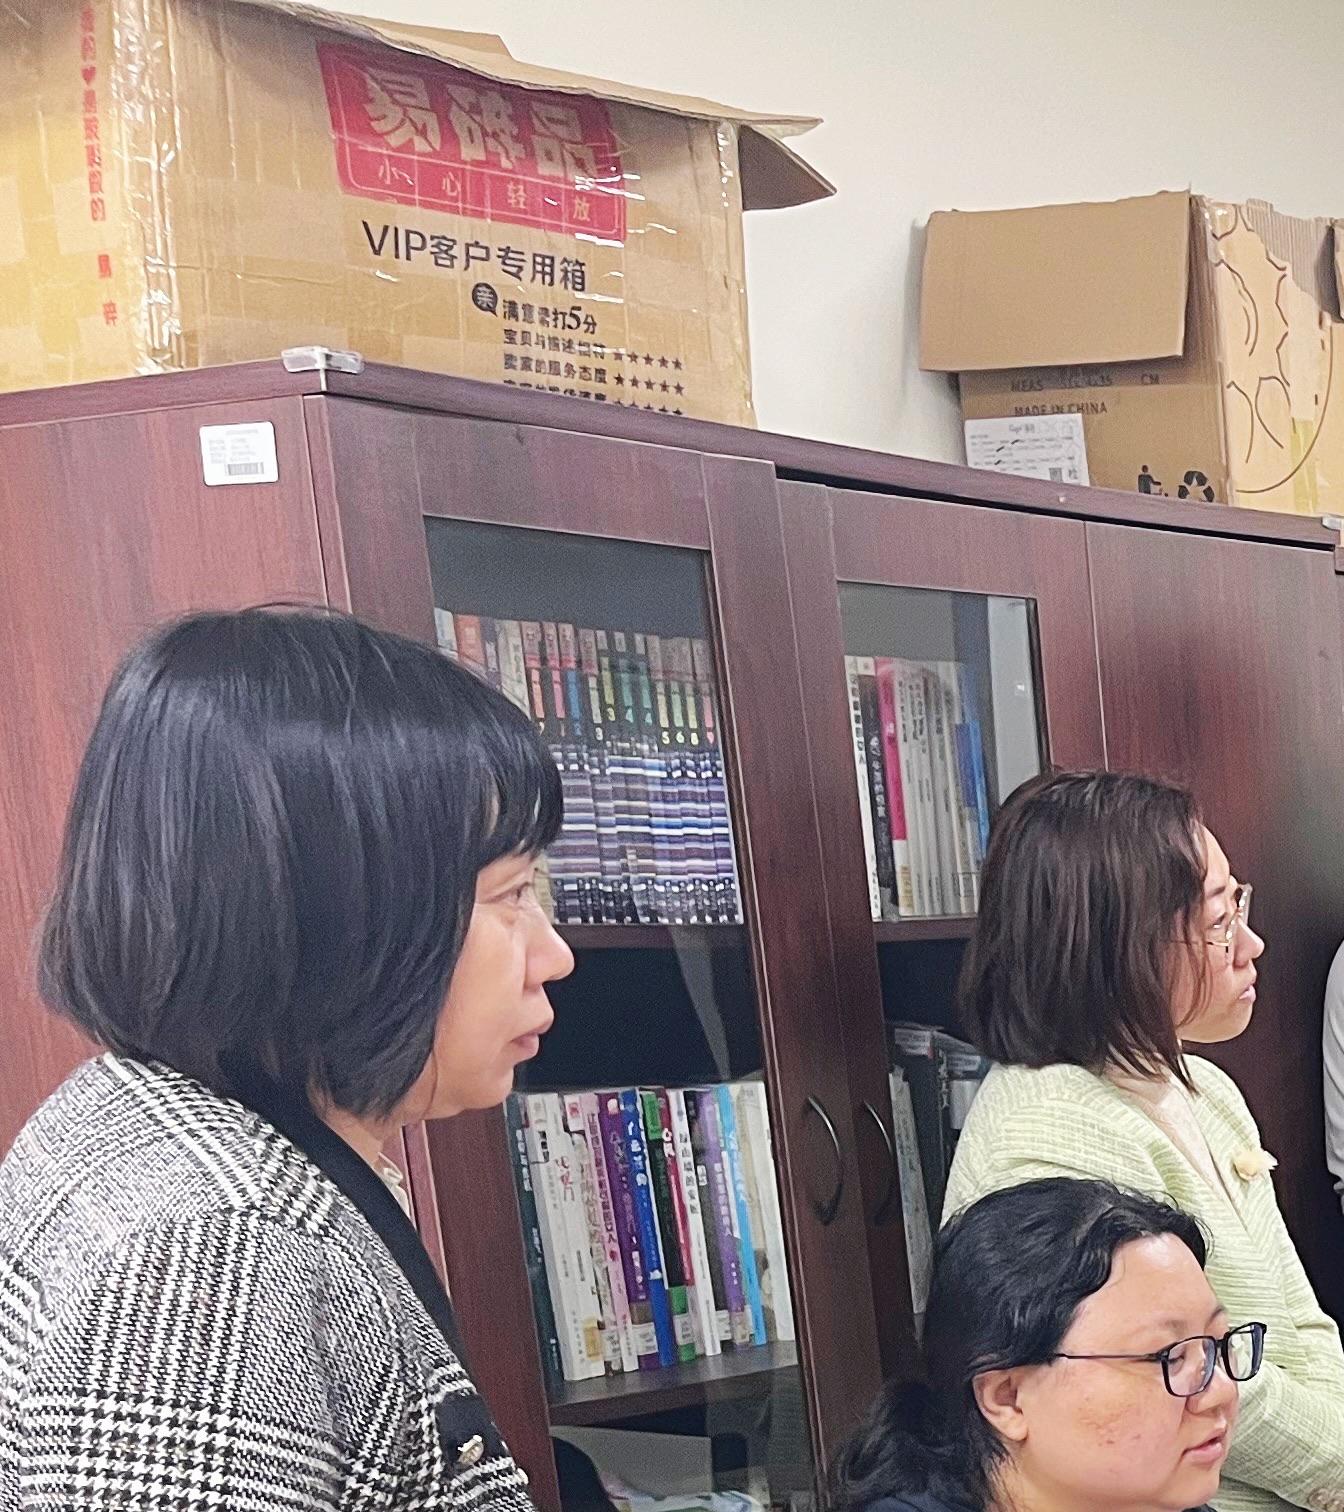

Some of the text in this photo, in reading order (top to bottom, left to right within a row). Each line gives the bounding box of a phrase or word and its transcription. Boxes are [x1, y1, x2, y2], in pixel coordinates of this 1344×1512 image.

[363, 66, 599, 182] 易碎品
[378, 157, 591, 222] 小心轻放
[362, 220, 586, 292] VIP客户专用箱
